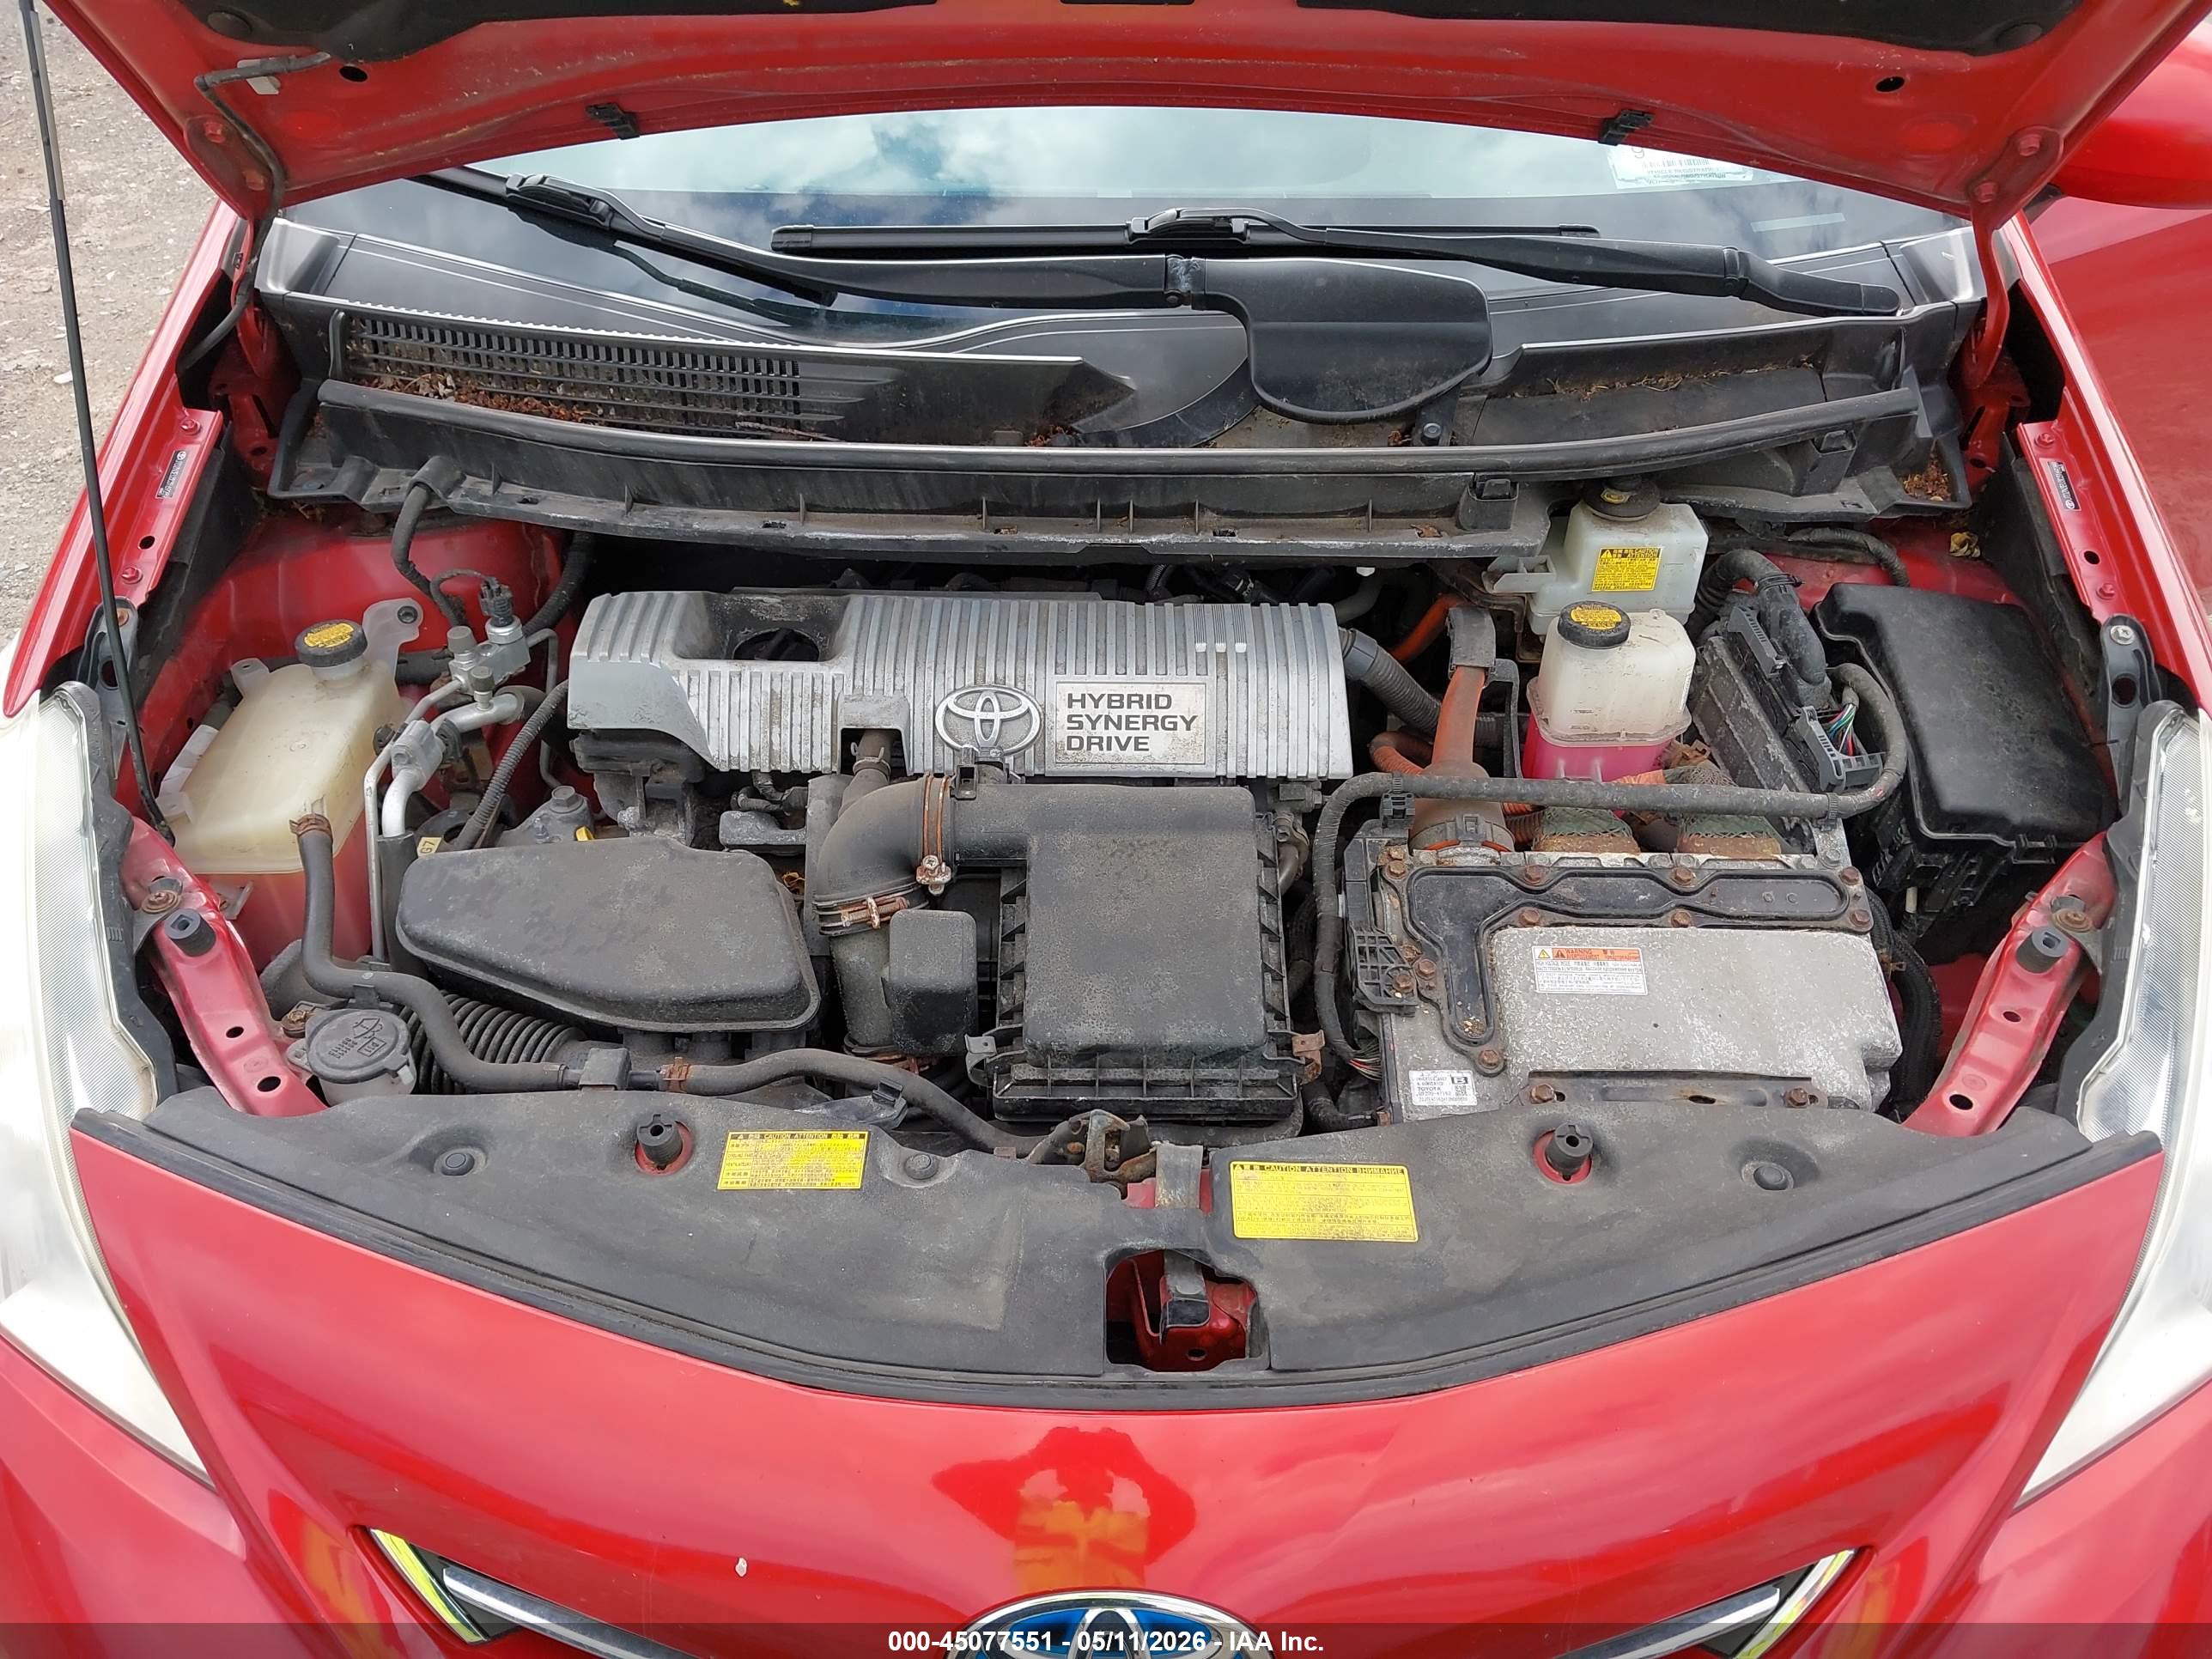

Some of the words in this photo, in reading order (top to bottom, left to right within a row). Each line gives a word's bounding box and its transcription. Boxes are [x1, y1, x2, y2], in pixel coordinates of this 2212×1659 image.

[1067, 693, 1172, 709] HYBRID
[1066, 714, 1198, 732] SYNERGY
[1066, 735, 1150, 751] DRIVE
[421, 841, 434, 854] G7
